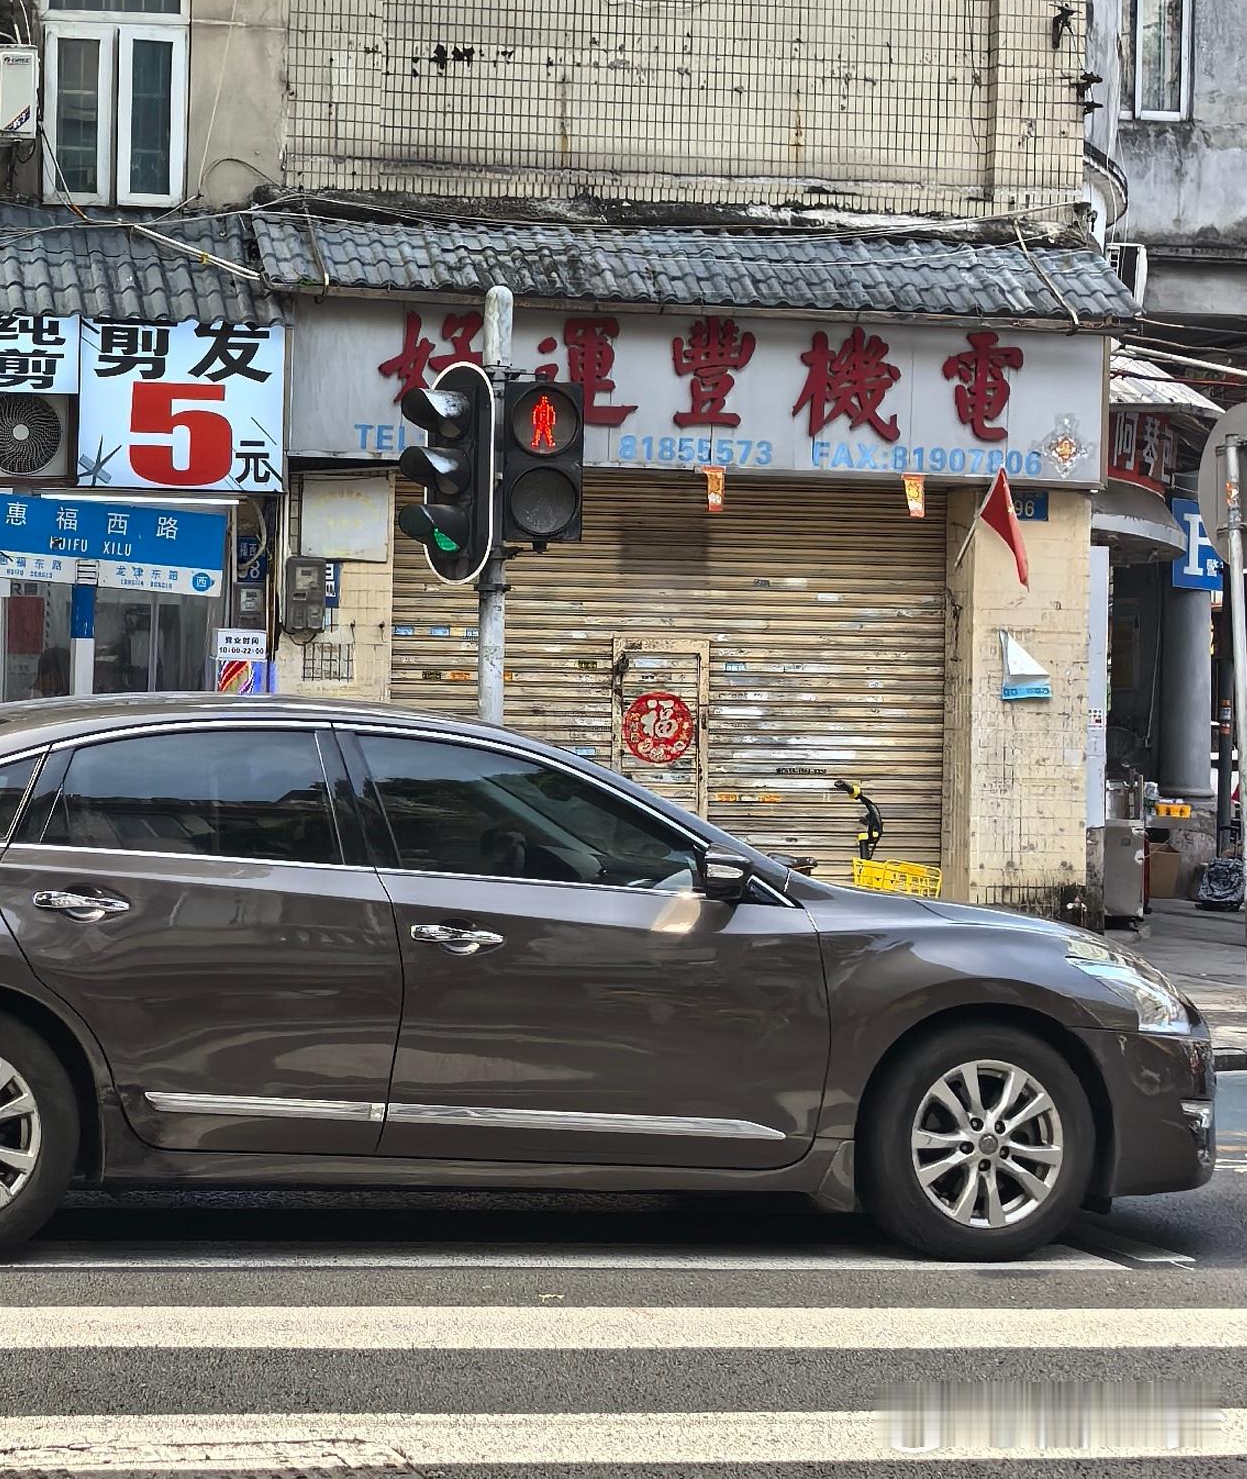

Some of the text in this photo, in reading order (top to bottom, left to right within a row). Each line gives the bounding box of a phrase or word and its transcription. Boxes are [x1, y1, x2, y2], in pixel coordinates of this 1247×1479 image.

[5, 501, 179, 540] 惠福西路
[103, 541, 132, 557] XILU
[641, 699, 678, 738] 福
